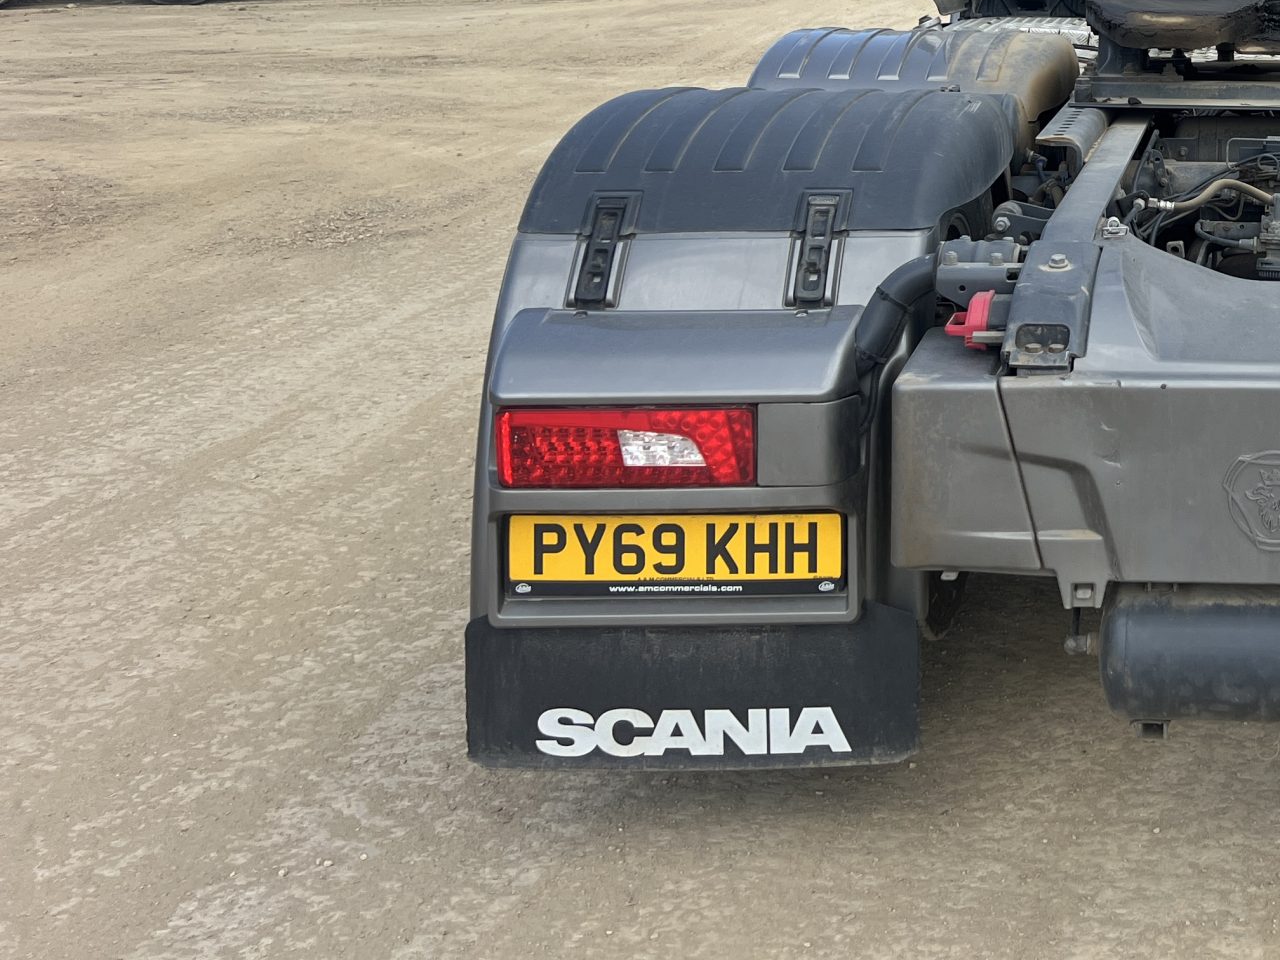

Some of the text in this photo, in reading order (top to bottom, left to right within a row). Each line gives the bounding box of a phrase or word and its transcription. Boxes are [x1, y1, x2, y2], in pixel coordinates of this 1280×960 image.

[533, 522, 818, 575] PY69 KHH
[609, 584, 743, 593] www.amcommercials.com
[535, 706, 852, 757] SCANIA
